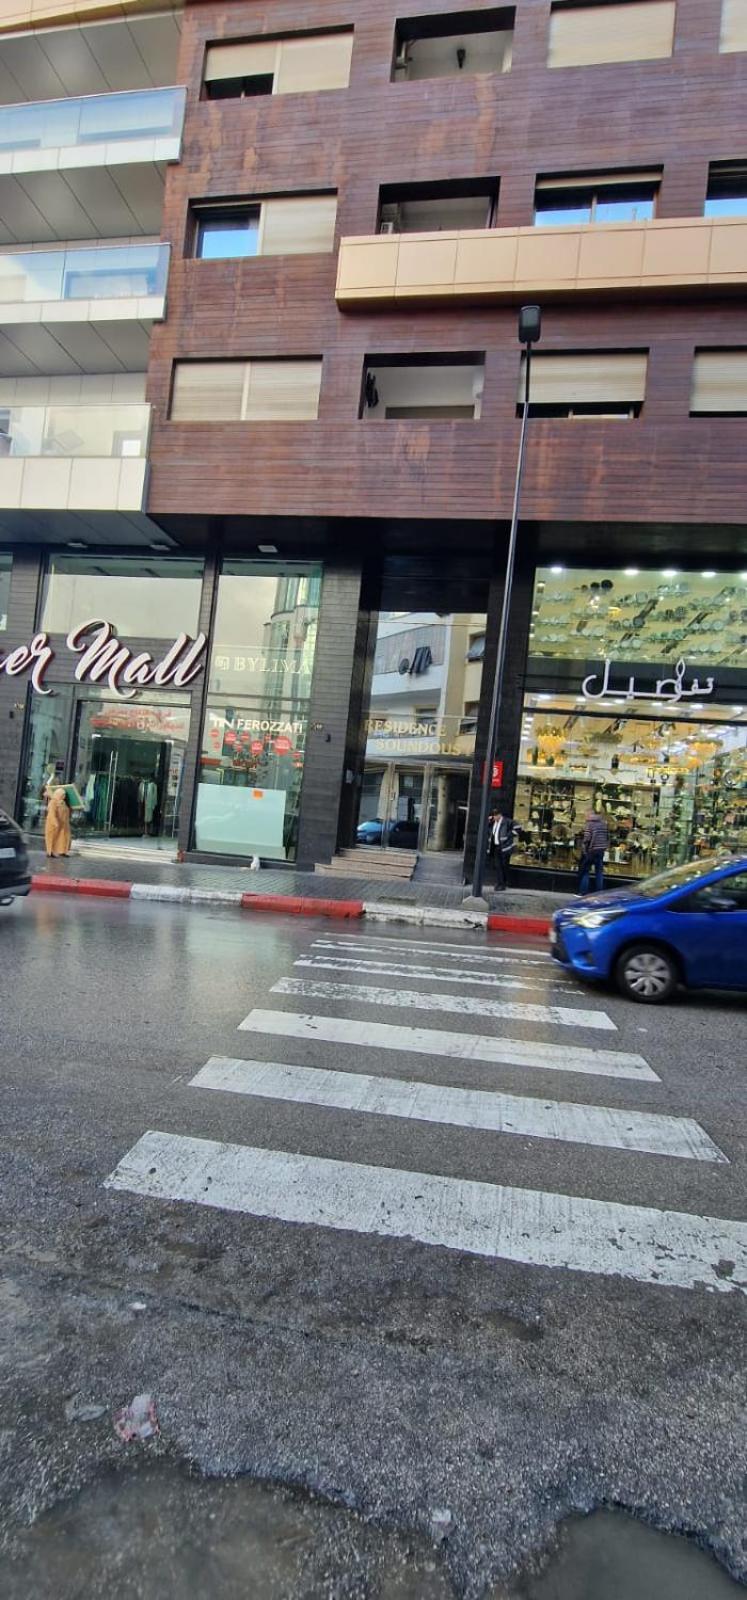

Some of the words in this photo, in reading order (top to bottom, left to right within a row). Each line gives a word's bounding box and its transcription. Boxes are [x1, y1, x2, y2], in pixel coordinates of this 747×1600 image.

[0, 633, 55, 695] er
[66, 618, 207, 699] Mall
[236, 718, 304, 734] FEROZZATI
[365, 719, 448, 737] RESIDENCE
[376, 739, 461, 757] SOUNDOUS
